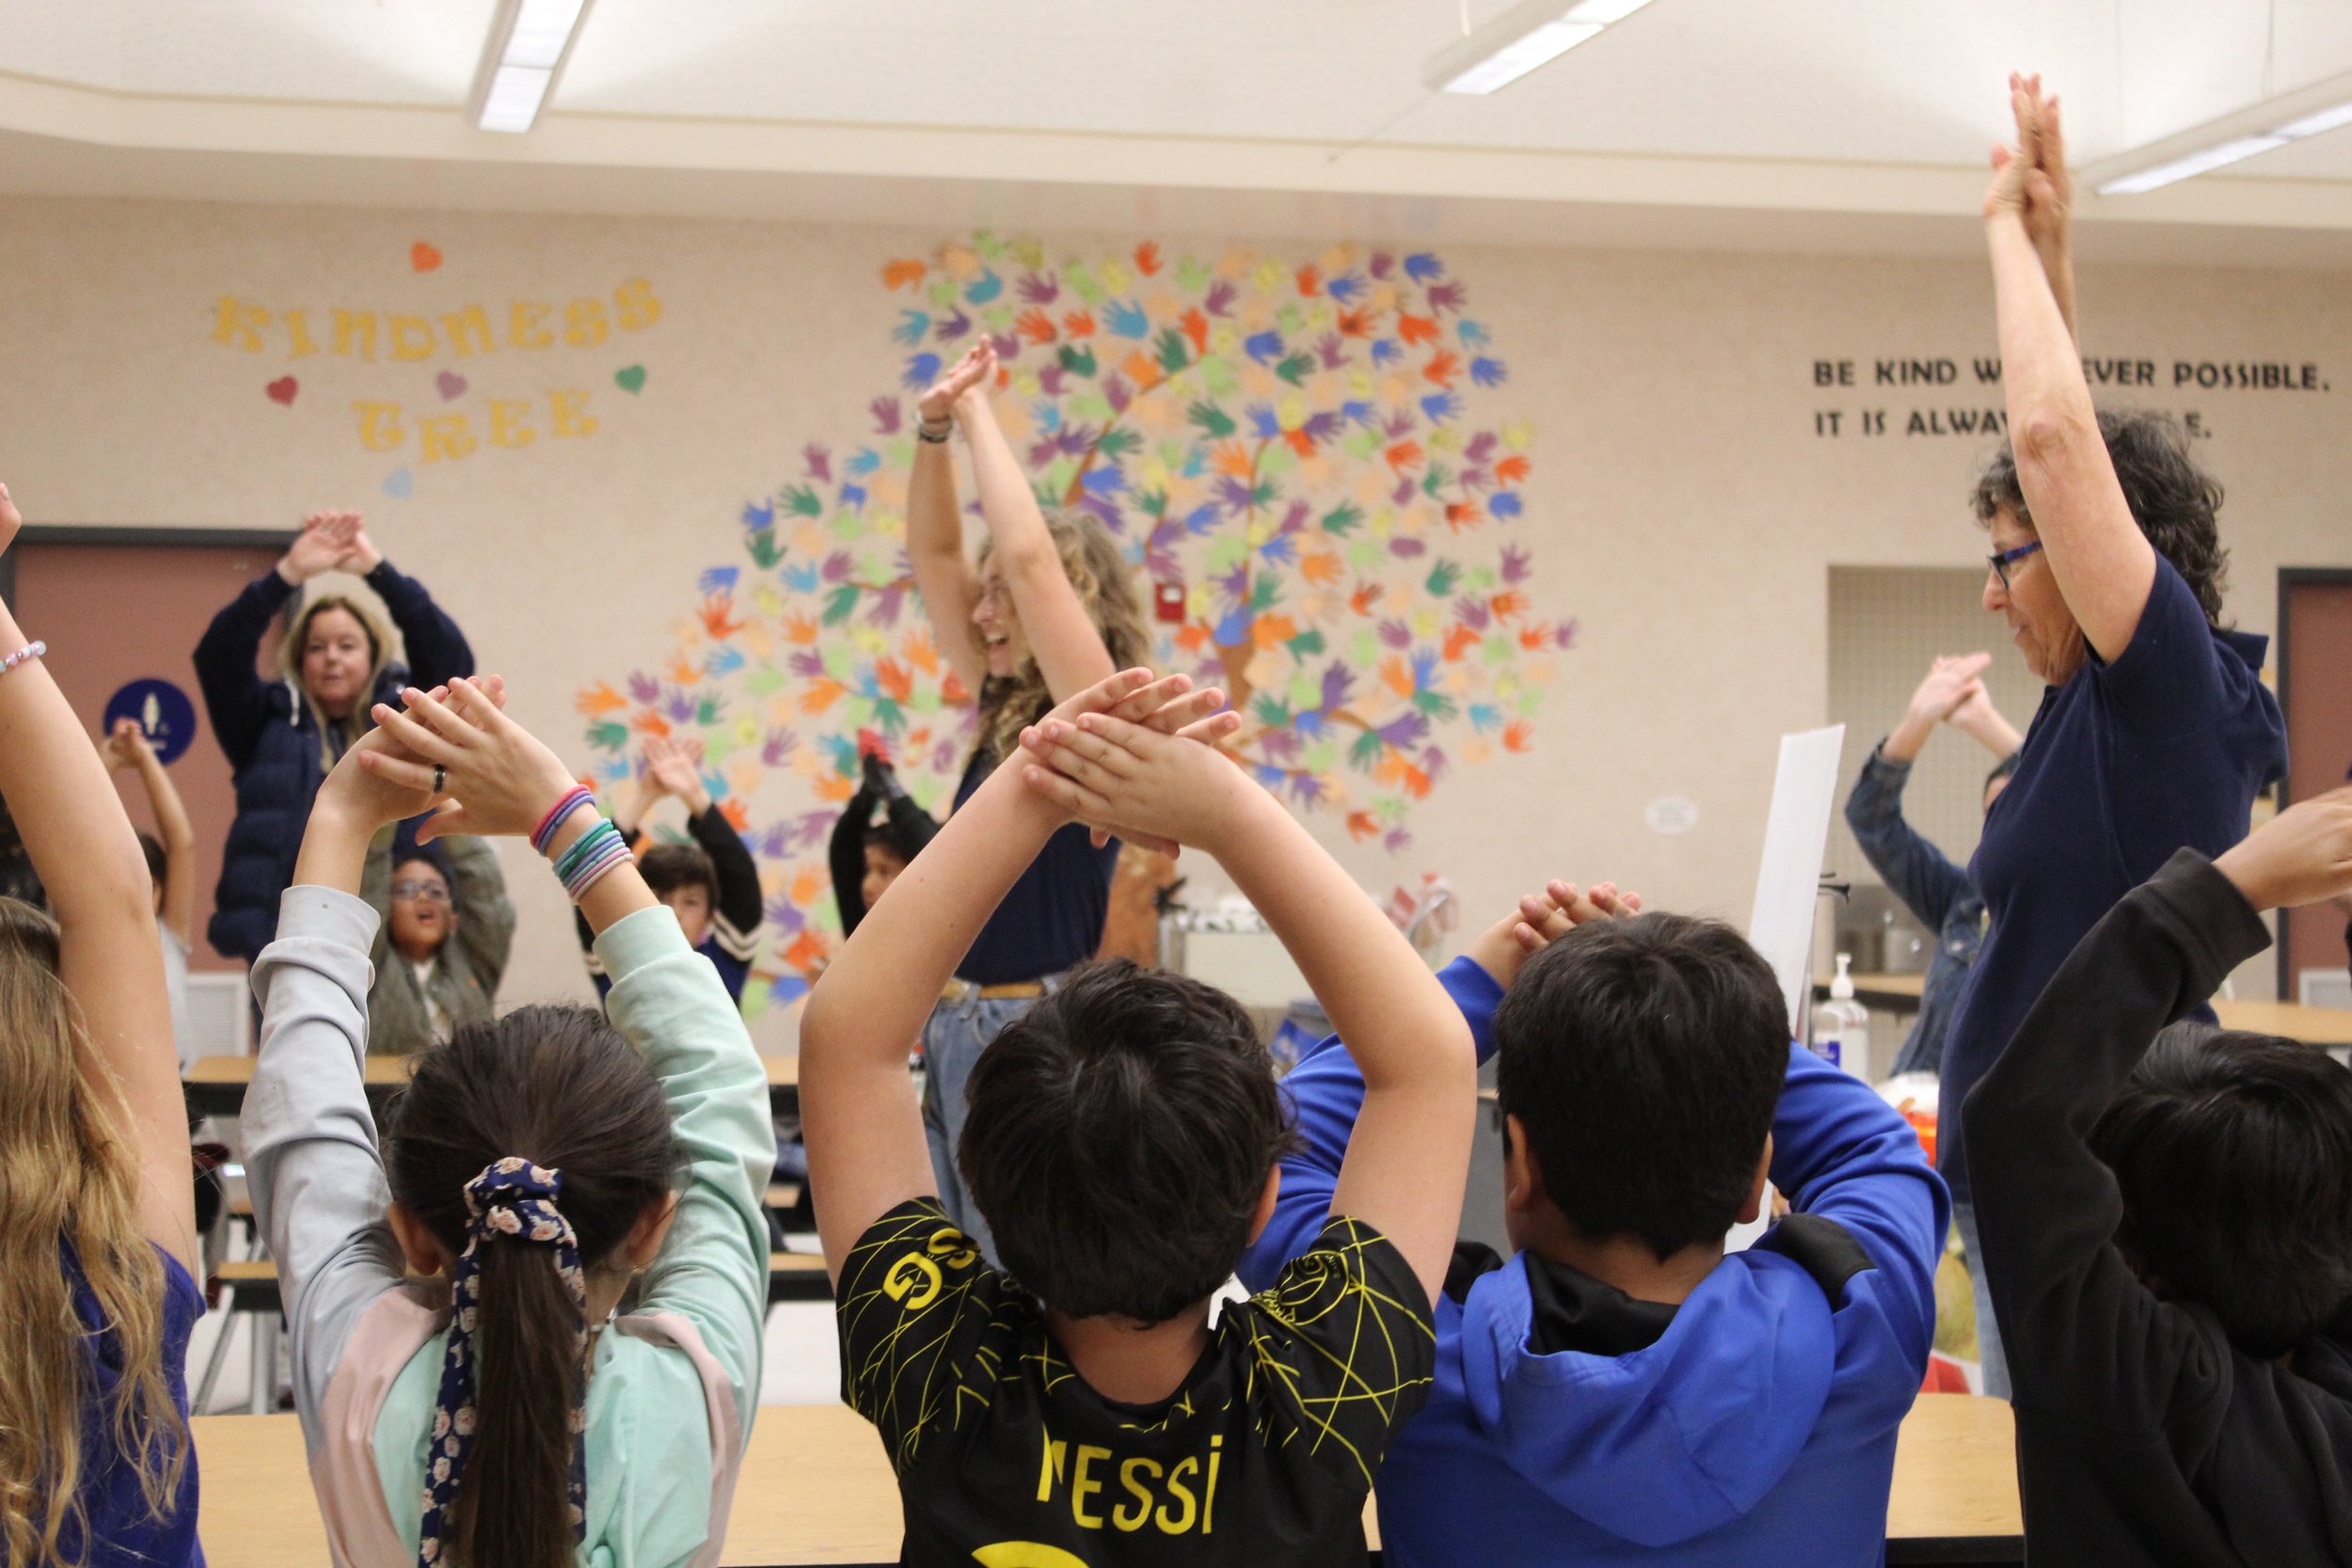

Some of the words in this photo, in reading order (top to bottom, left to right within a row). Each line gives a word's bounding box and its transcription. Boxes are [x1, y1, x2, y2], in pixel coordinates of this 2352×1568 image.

[212, 278, 662, 361] KINDNESS
[1814, 361, 1854, 387] BE
[1876, 359, 1957, 385] KIND
[2174, 362, 2330, 391] POSSIBLE.
[351, 390, 599, 463] TREE
[1816, 411, 1841, 436] IT
[1863, 411, 1885, 436] IS
